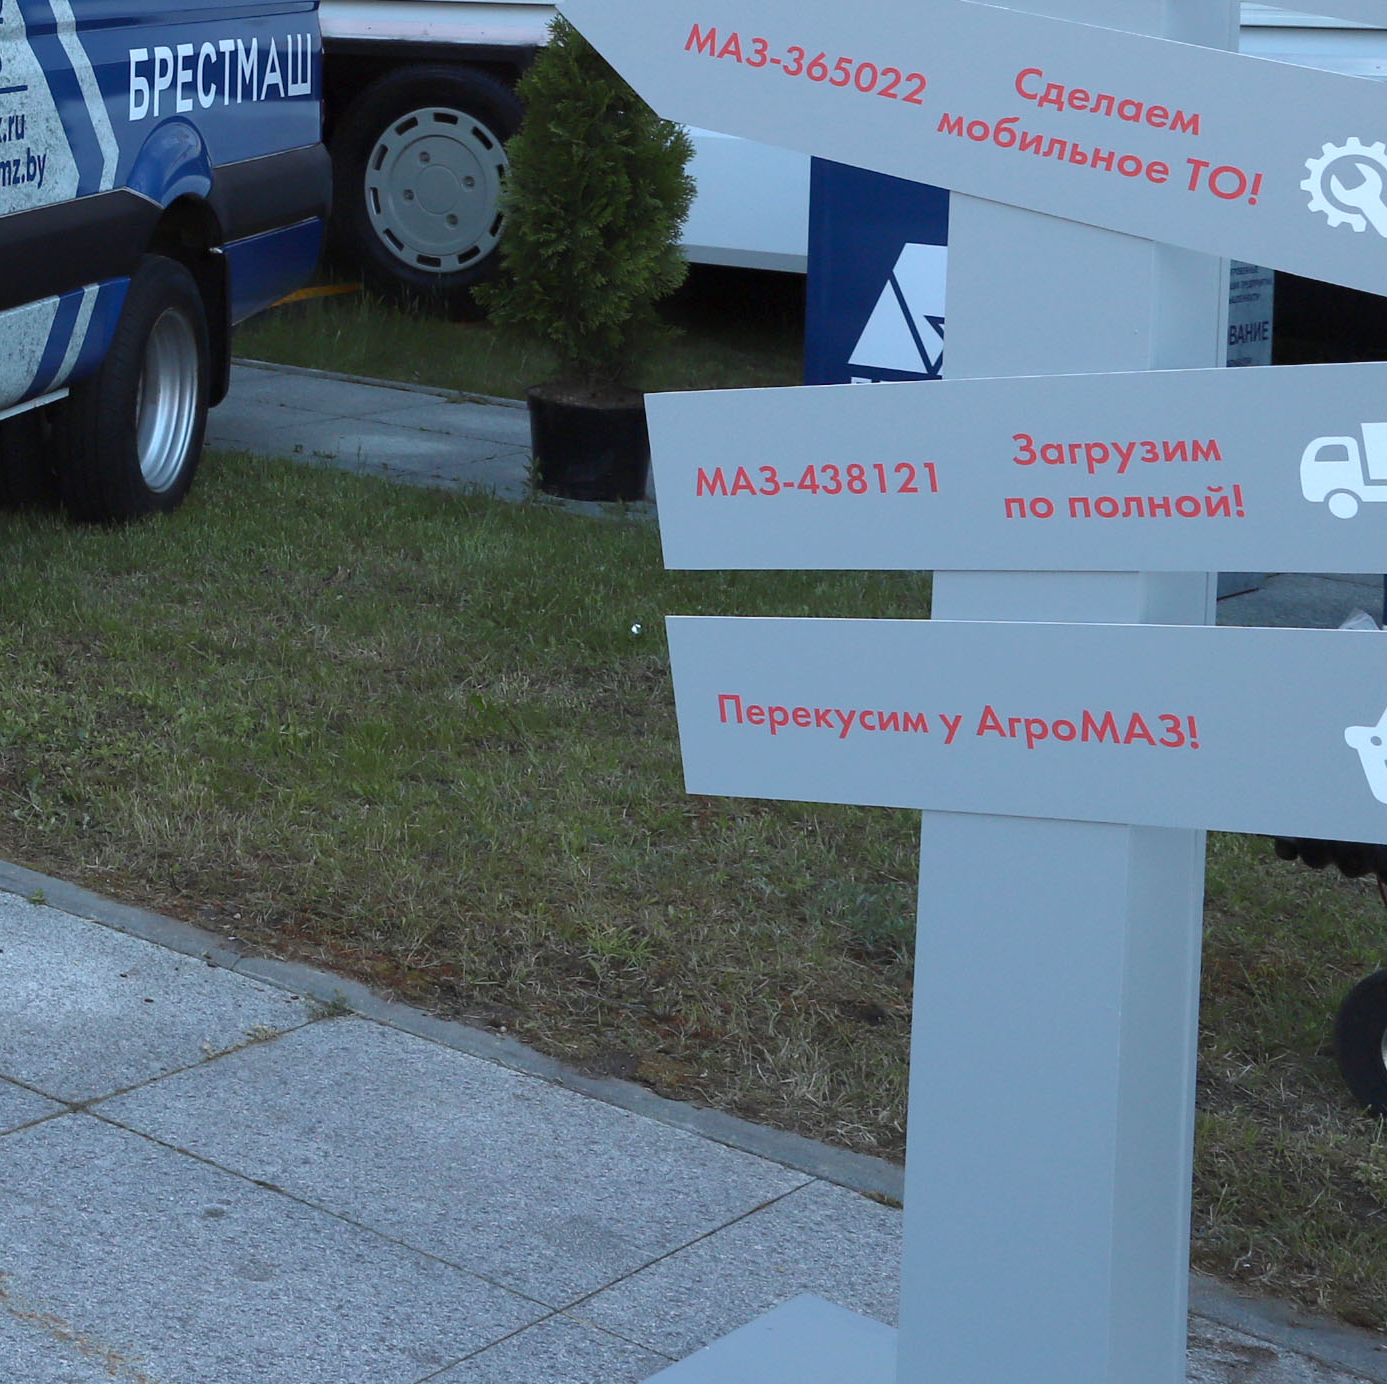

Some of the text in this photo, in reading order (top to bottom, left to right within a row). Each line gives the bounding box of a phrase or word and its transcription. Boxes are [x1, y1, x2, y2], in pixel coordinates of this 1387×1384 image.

[127, 32, 313, 122] БРЕСТМАШ
[683, 22, 929, 107] МАЗ-365022
[1013, 66, 1202, 137] Сделаем
[935, 111, 1264, 207] мобильное ТО!
[1228, 320, 1270, 346] ВАНИЕ
[695, 460, 941, 498] МАЗ-438121
[1010, 432, 1224, 477] Загрузим
[1003, 483, 1247, 520] по полной!
[716, 692, 1202, 751] Перекусим у АгроМАЗ!
